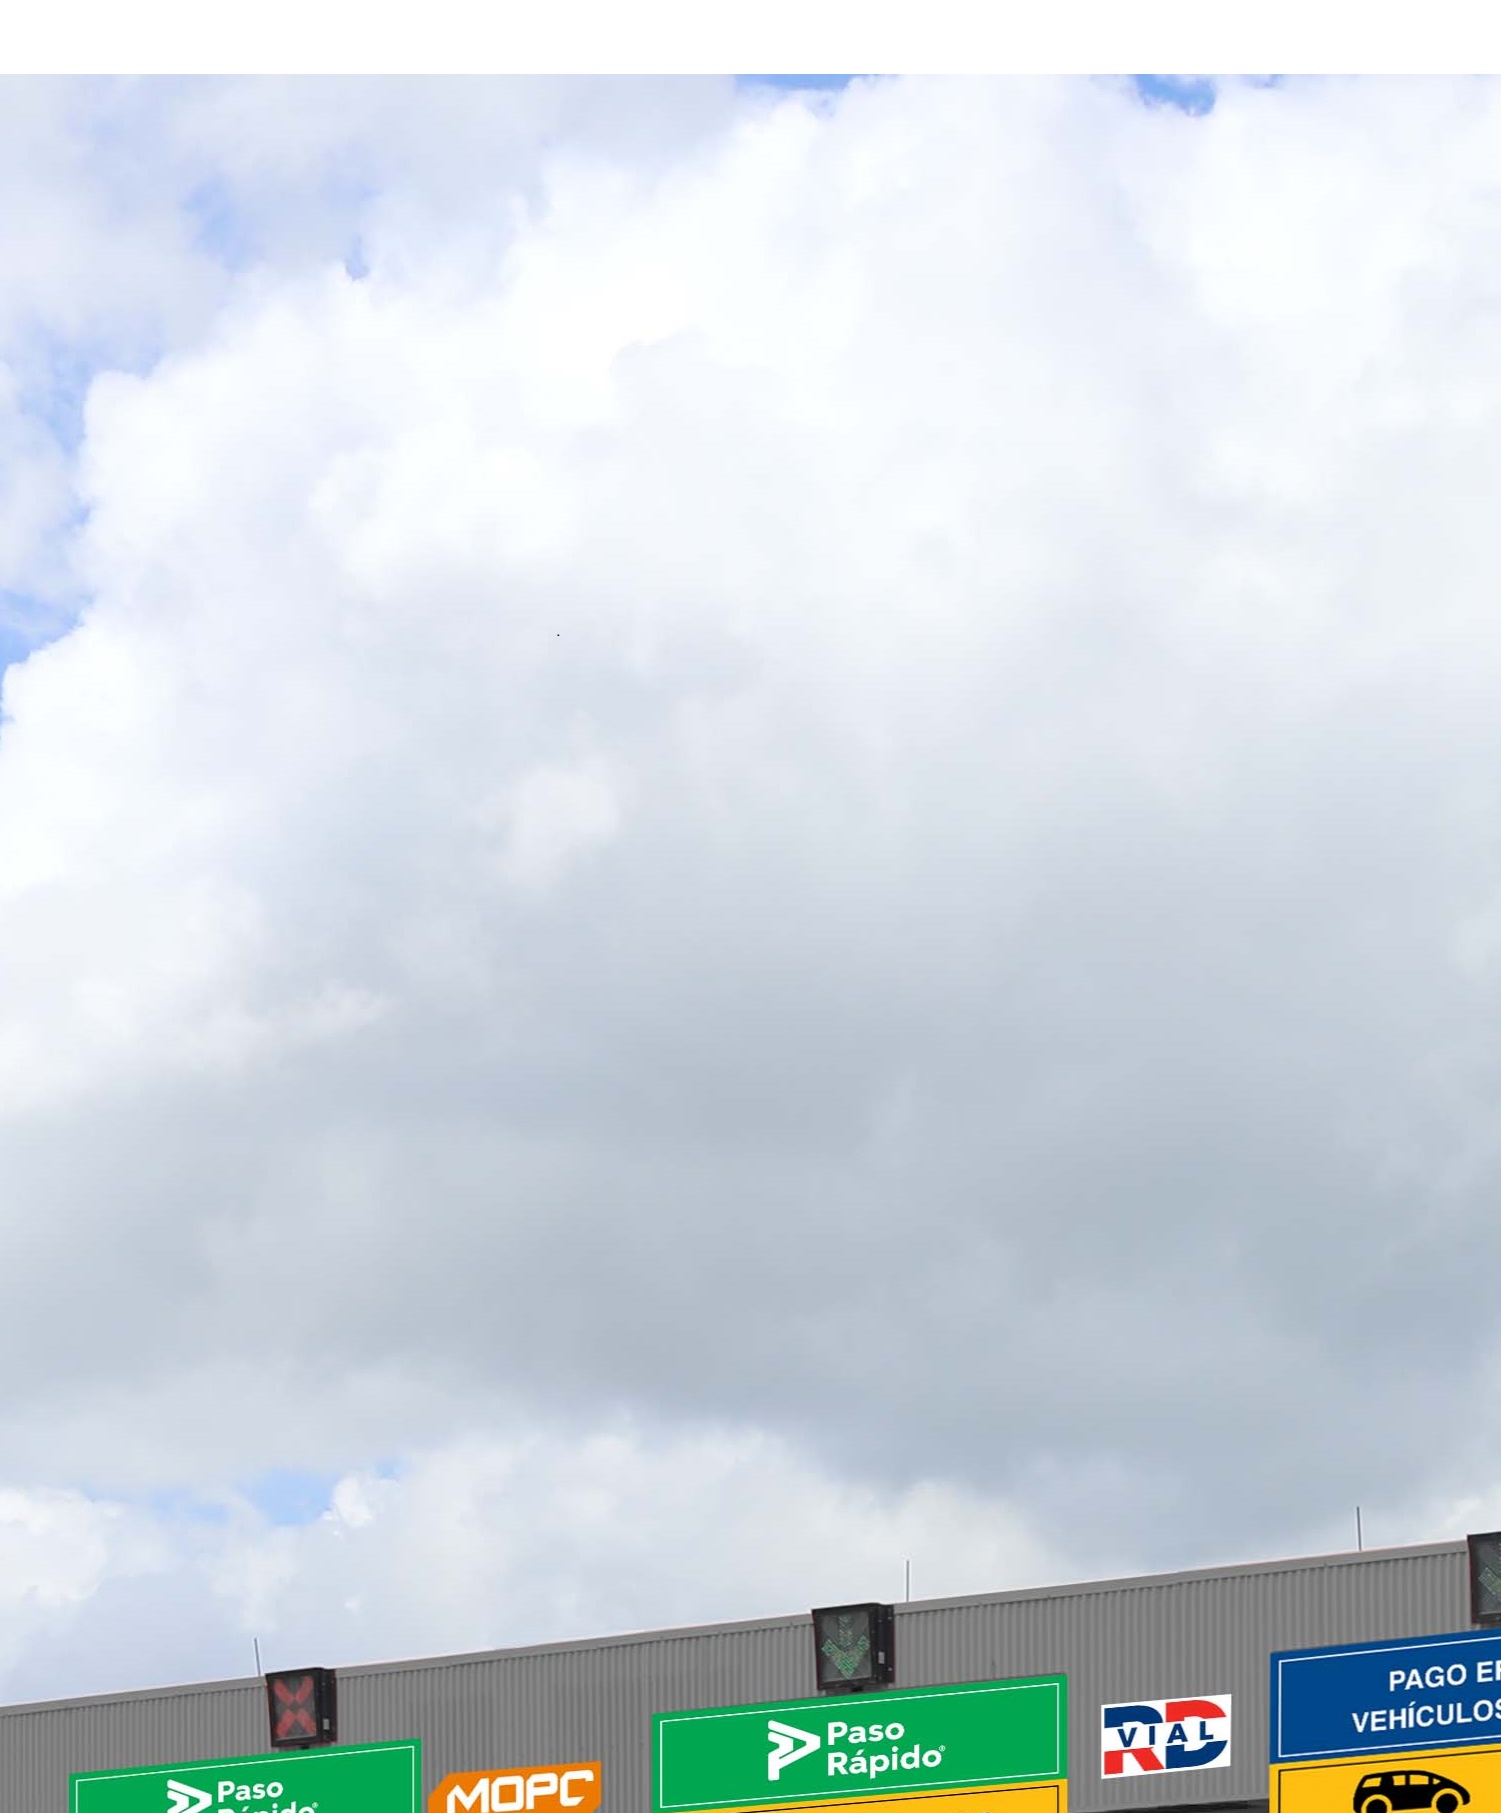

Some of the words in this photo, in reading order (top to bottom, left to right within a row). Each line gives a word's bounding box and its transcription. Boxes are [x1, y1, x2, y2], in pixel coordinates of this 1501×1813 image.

[1389, 1663, 1467, 1692] PAGO
[827, 1721, 905, 1746] Paso
[1116, 1720, 1214, 1748] VIAL
[217, 1780, 284, 1803] Paso
